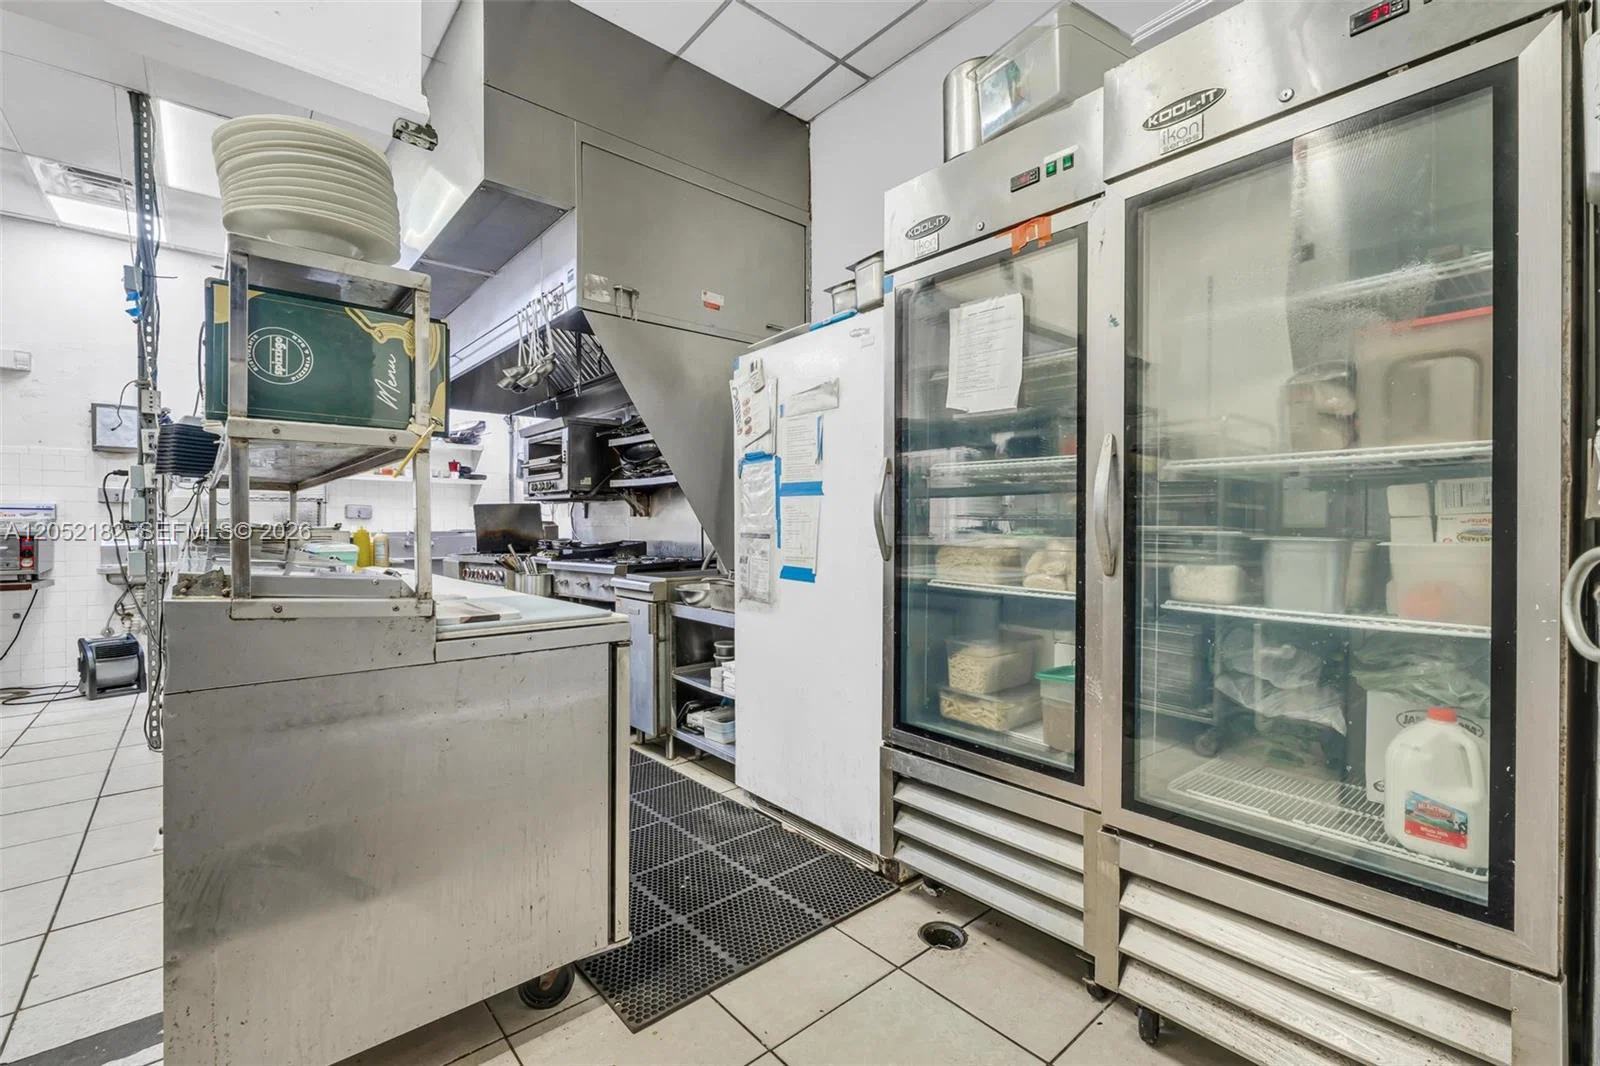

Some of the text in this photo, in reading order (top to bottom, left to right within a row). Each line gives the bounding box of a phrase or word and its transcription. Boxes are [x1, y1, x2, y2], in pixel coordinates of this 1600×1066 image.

[1147, 88, 1218, 128] KOOL-IT
[1162, 121, 1200, 145] ikon
[907, 215, 945, 238] KOOL-IT
[291, 335, 306, 349] BAR
[271, 336, 287, 376] spizzigo
[290, 356, 311, 382] PIZZERIA
[374, 353, 401, 410] Menu
